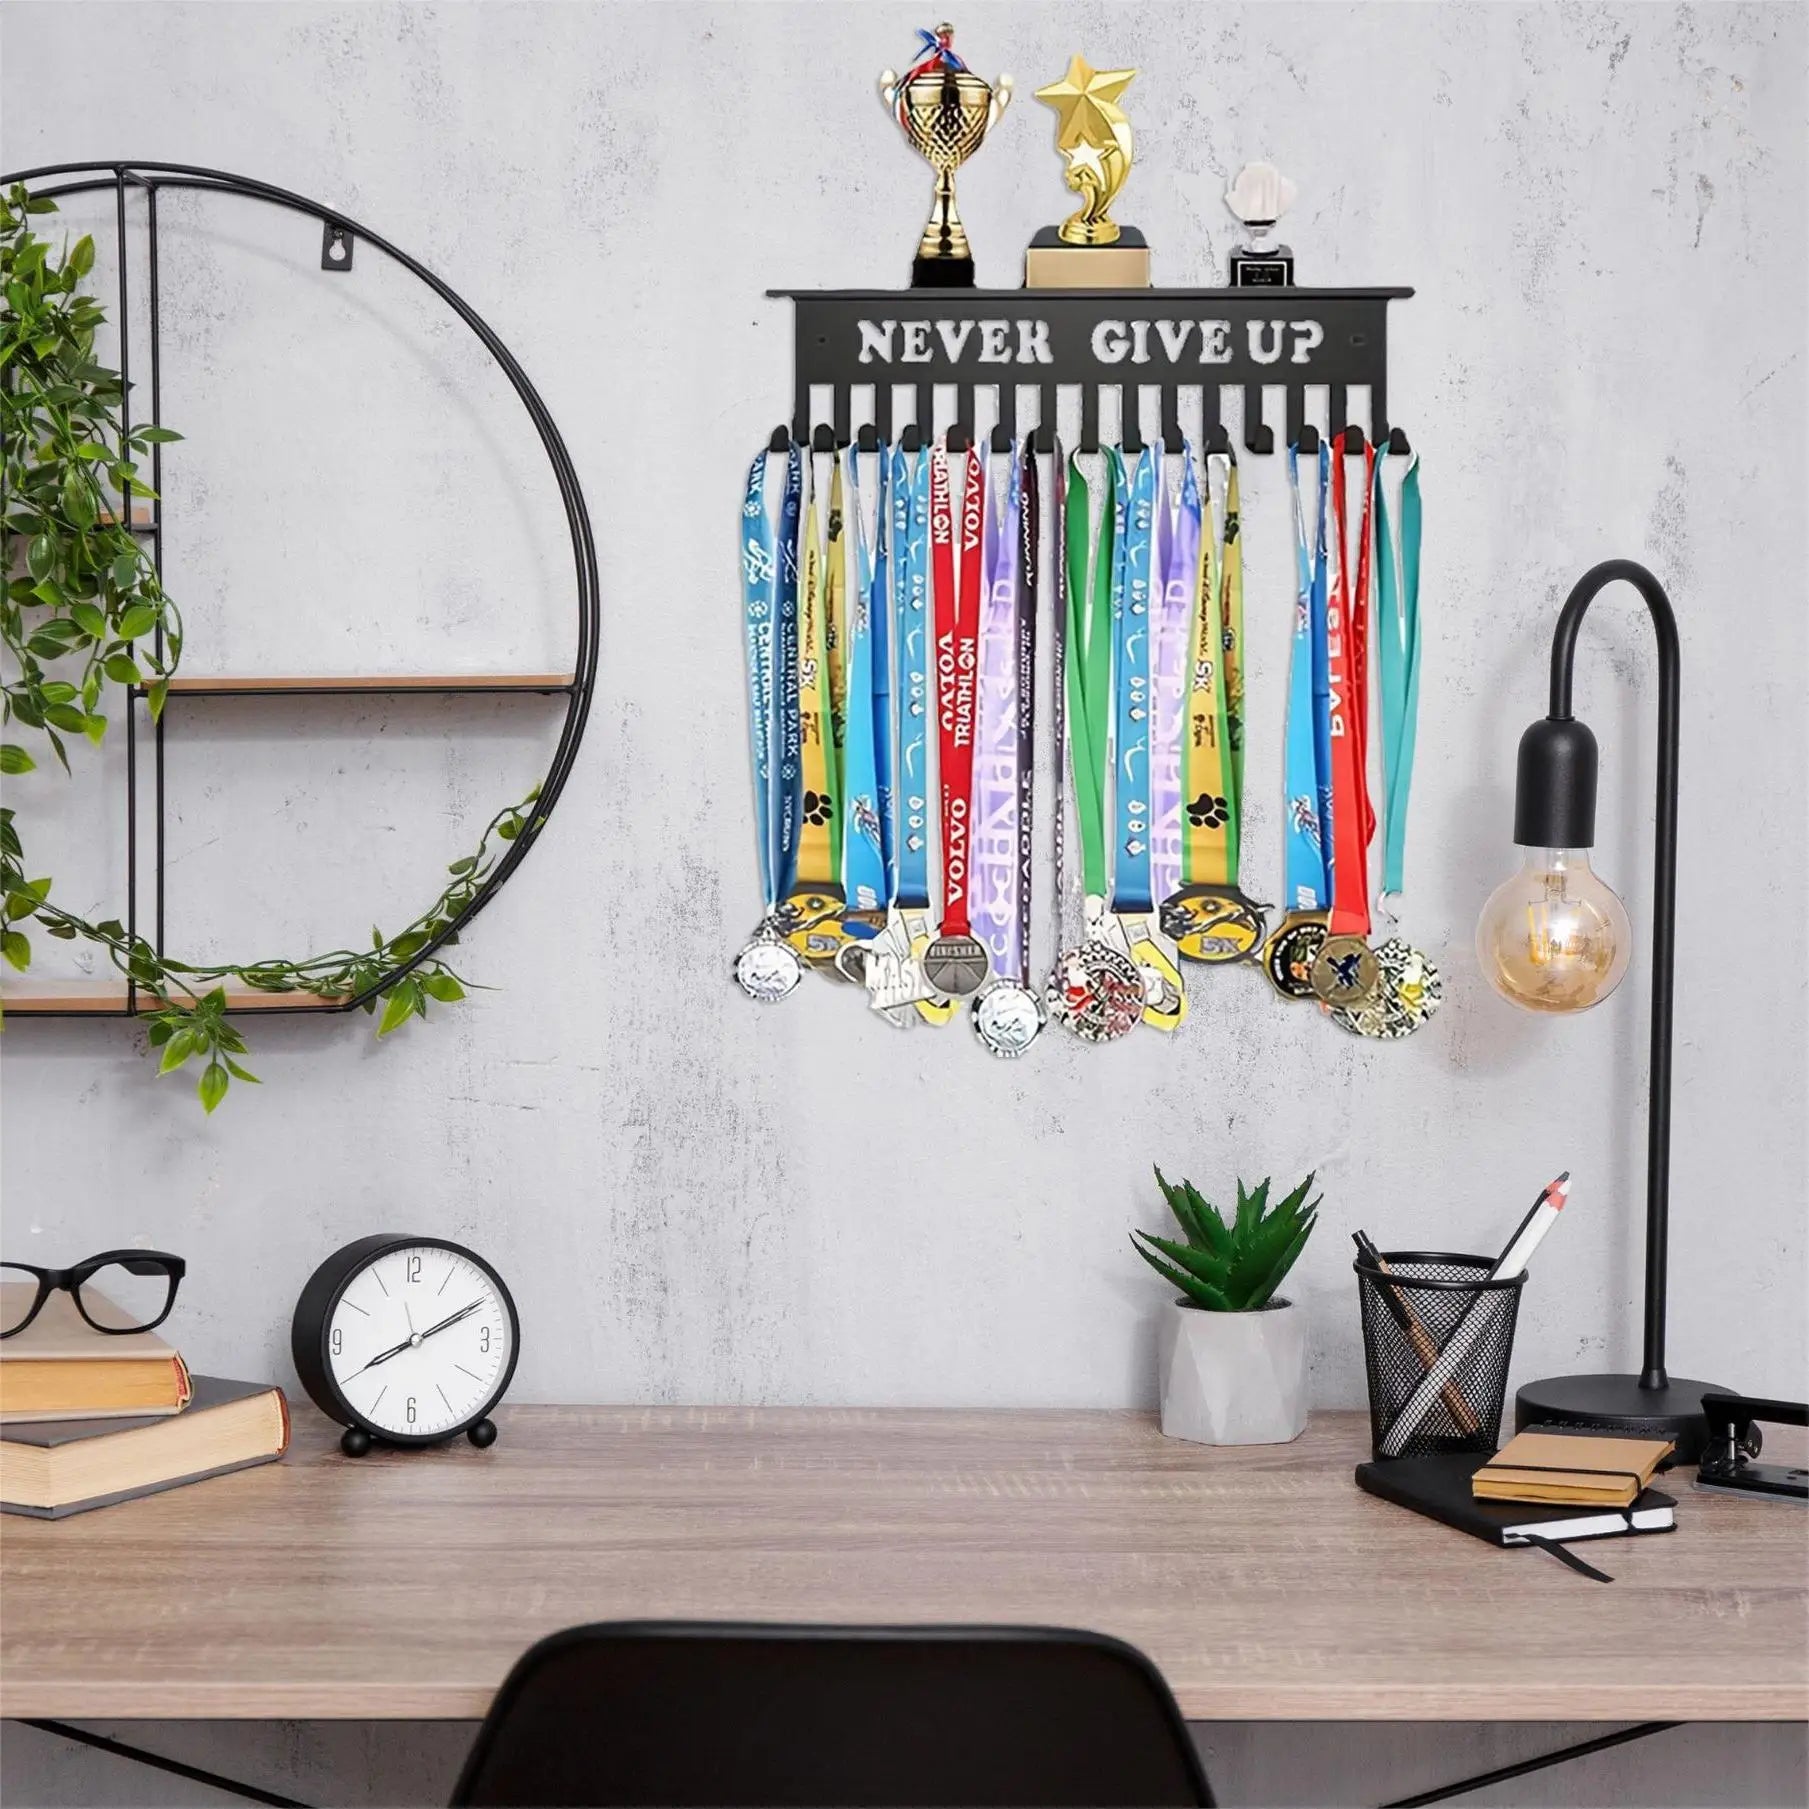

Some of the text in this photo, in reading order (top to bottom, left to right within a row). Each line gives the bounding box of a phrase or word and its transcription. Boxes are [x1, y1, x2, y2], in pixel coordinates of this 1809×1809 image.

[857, 320, 1324, 364] NEVER GIVE UP
[964, 458, 981, 552] VOLVO
[954, 638, 976, 748] TRIATHLON
[948, 798, 967, 906] VOLVO
[407, 1256, 421, 1283] 12
[332, 1328, 342, 1355] 9
[480, 1326, 490, 1353] 3
[406, 1397, 416, 1423] 6
